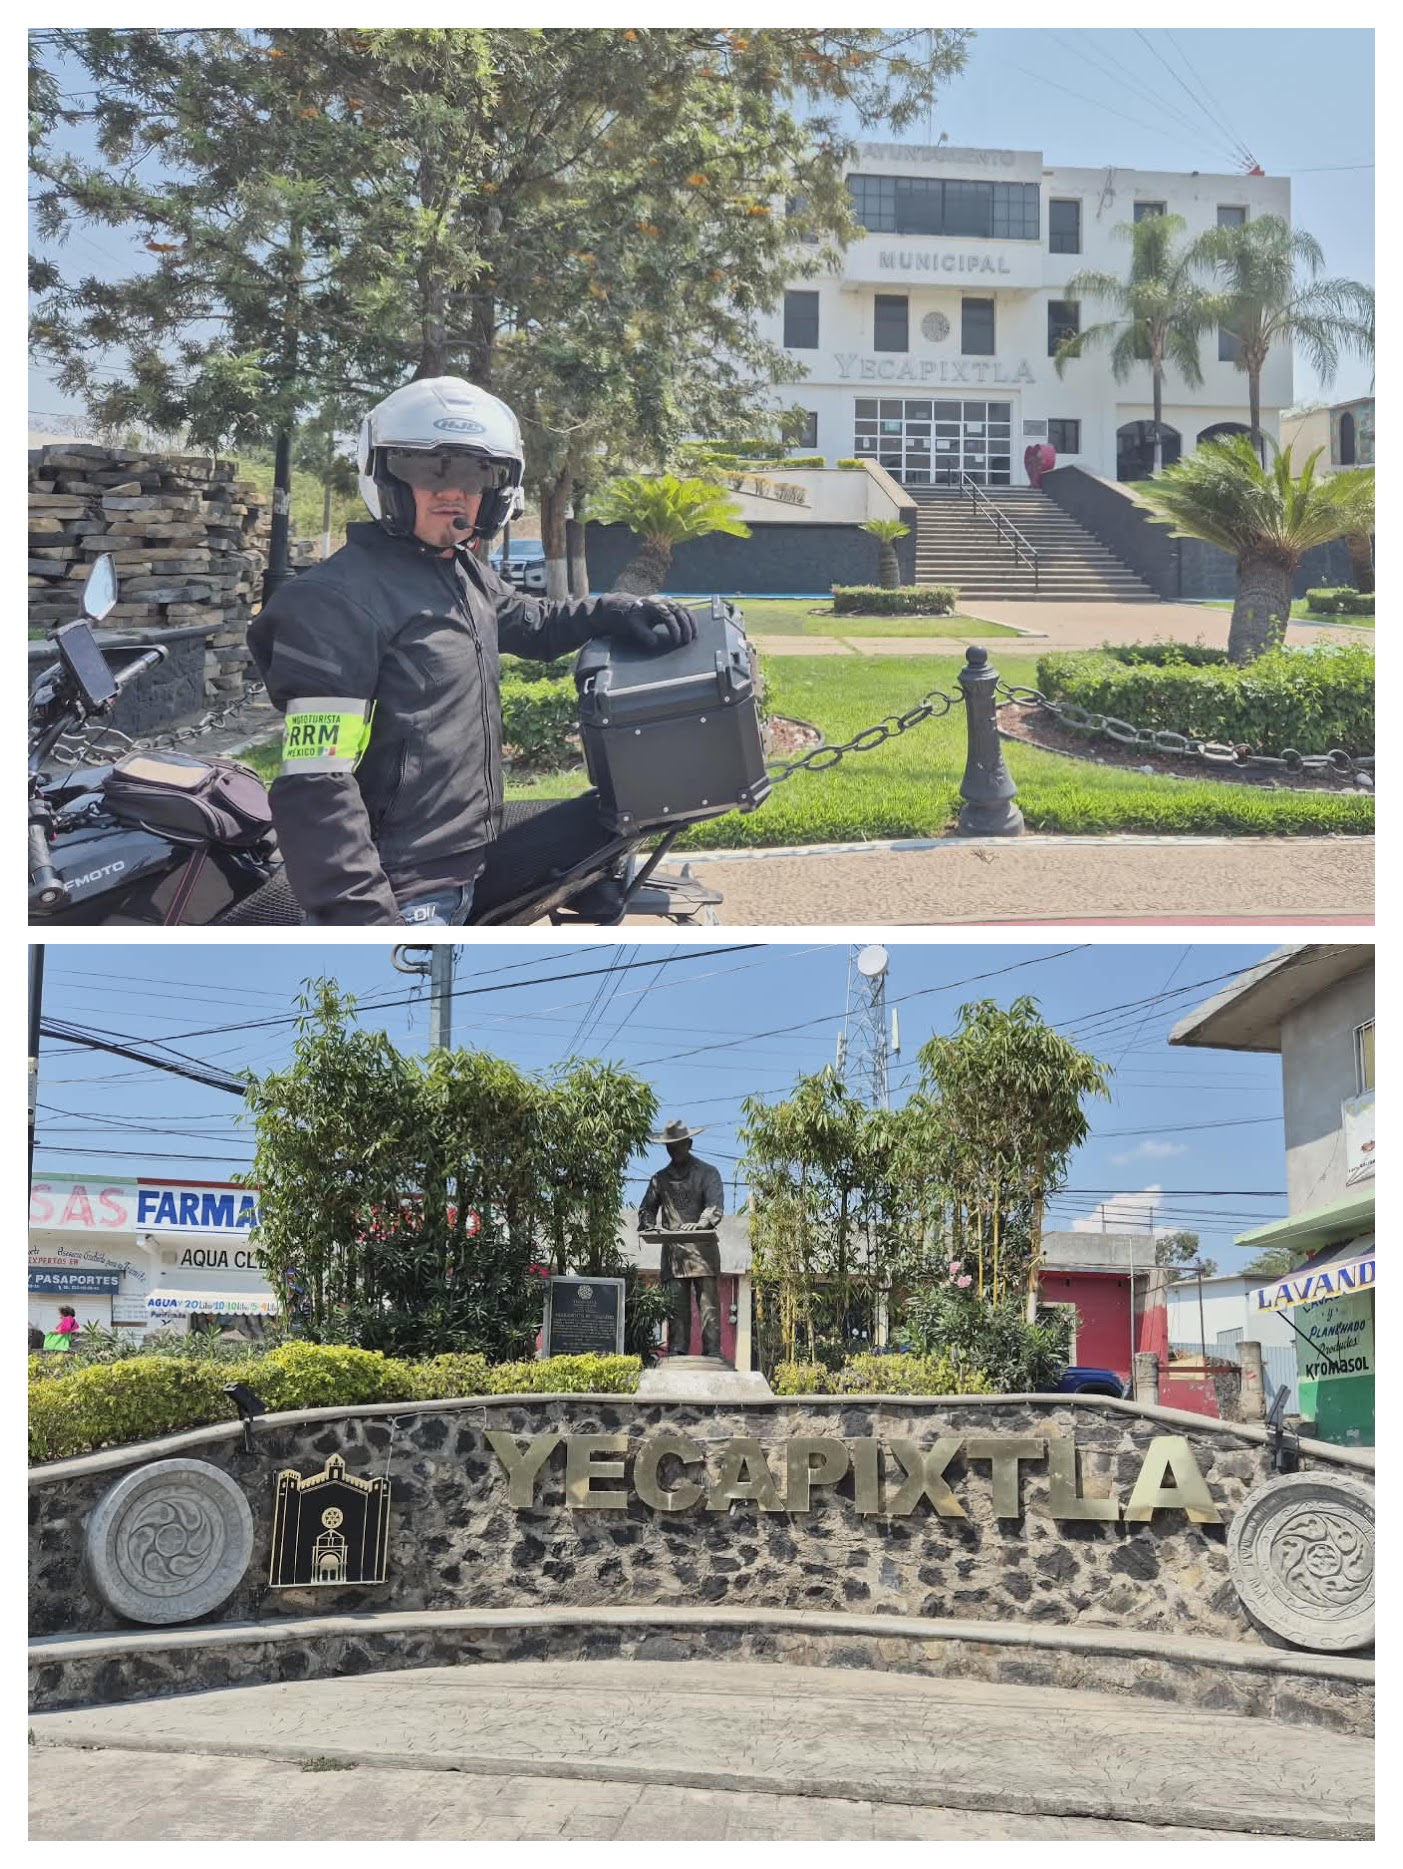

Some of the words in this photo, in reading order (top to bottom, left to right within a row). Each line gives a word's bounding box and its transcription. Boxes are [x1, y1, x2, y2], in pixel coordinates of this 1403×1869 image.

[879, 251, 1010, 274] MUNICIPAL
[834, 352, 1036, 384] YECAPIXTLA
[292, 714, 341, 724] MOTOTURISTA
[290, 724, 339, 746] RRM
[63, 860, 125, 893] FMOTO
[137, 1190, 264, 1228] FARMA
[180, 1248, 229, 1268] AQUA
[35, 1274, 119, 1285] PASAPORTES
[1258, 1261, 1375, 1309] LAVAND
[147, 1298, 178, 1308] AGUA
[1308, 1319, 1366, 1341] PLANCHADO
[484, 1430, 1223, 1524] YECAPIXTLA
